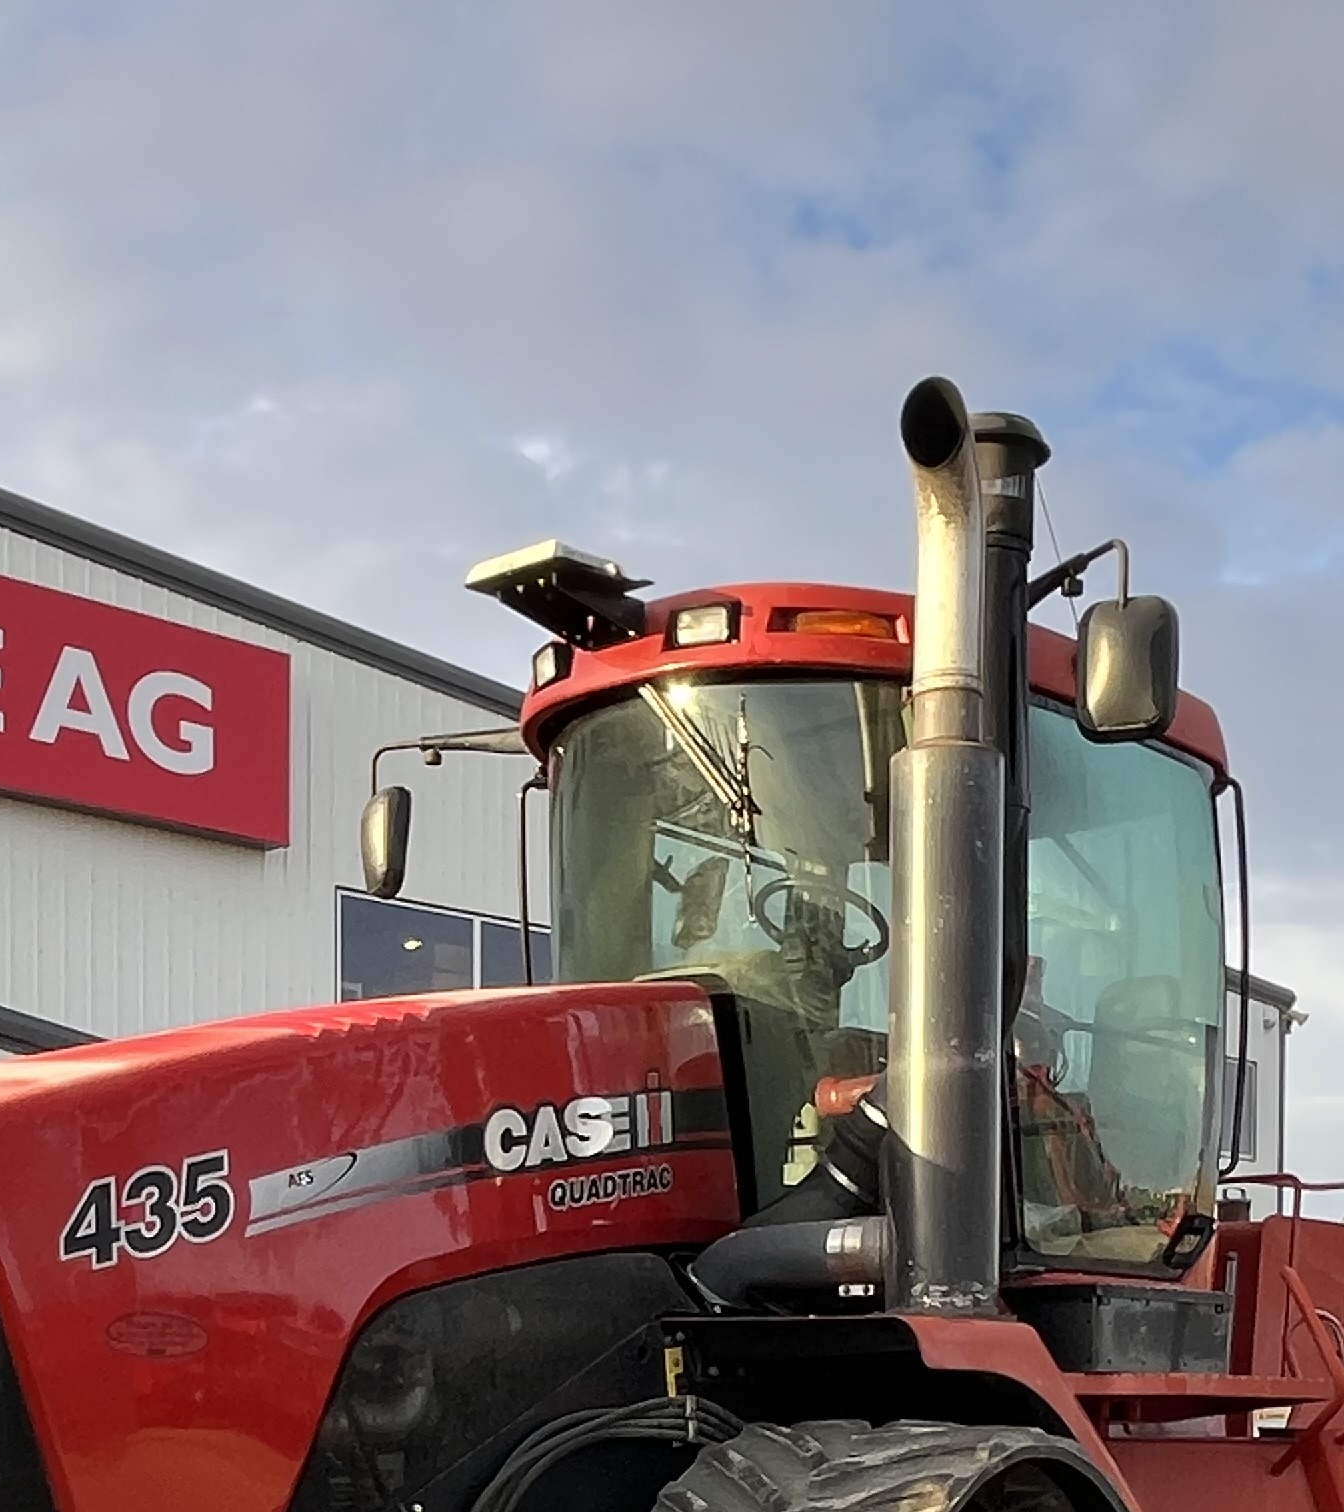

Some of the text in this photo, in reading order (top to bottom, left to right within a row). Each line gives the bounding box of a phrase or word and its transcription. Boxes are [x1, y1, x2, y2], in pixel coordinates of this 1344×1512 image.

[29, 645, 215, 775] AG
[484, 1096, 632, 1172] CASE
[59, 1149, 235, 1270] 435
[547, 1162, 674, 1211] QUADTRAC
